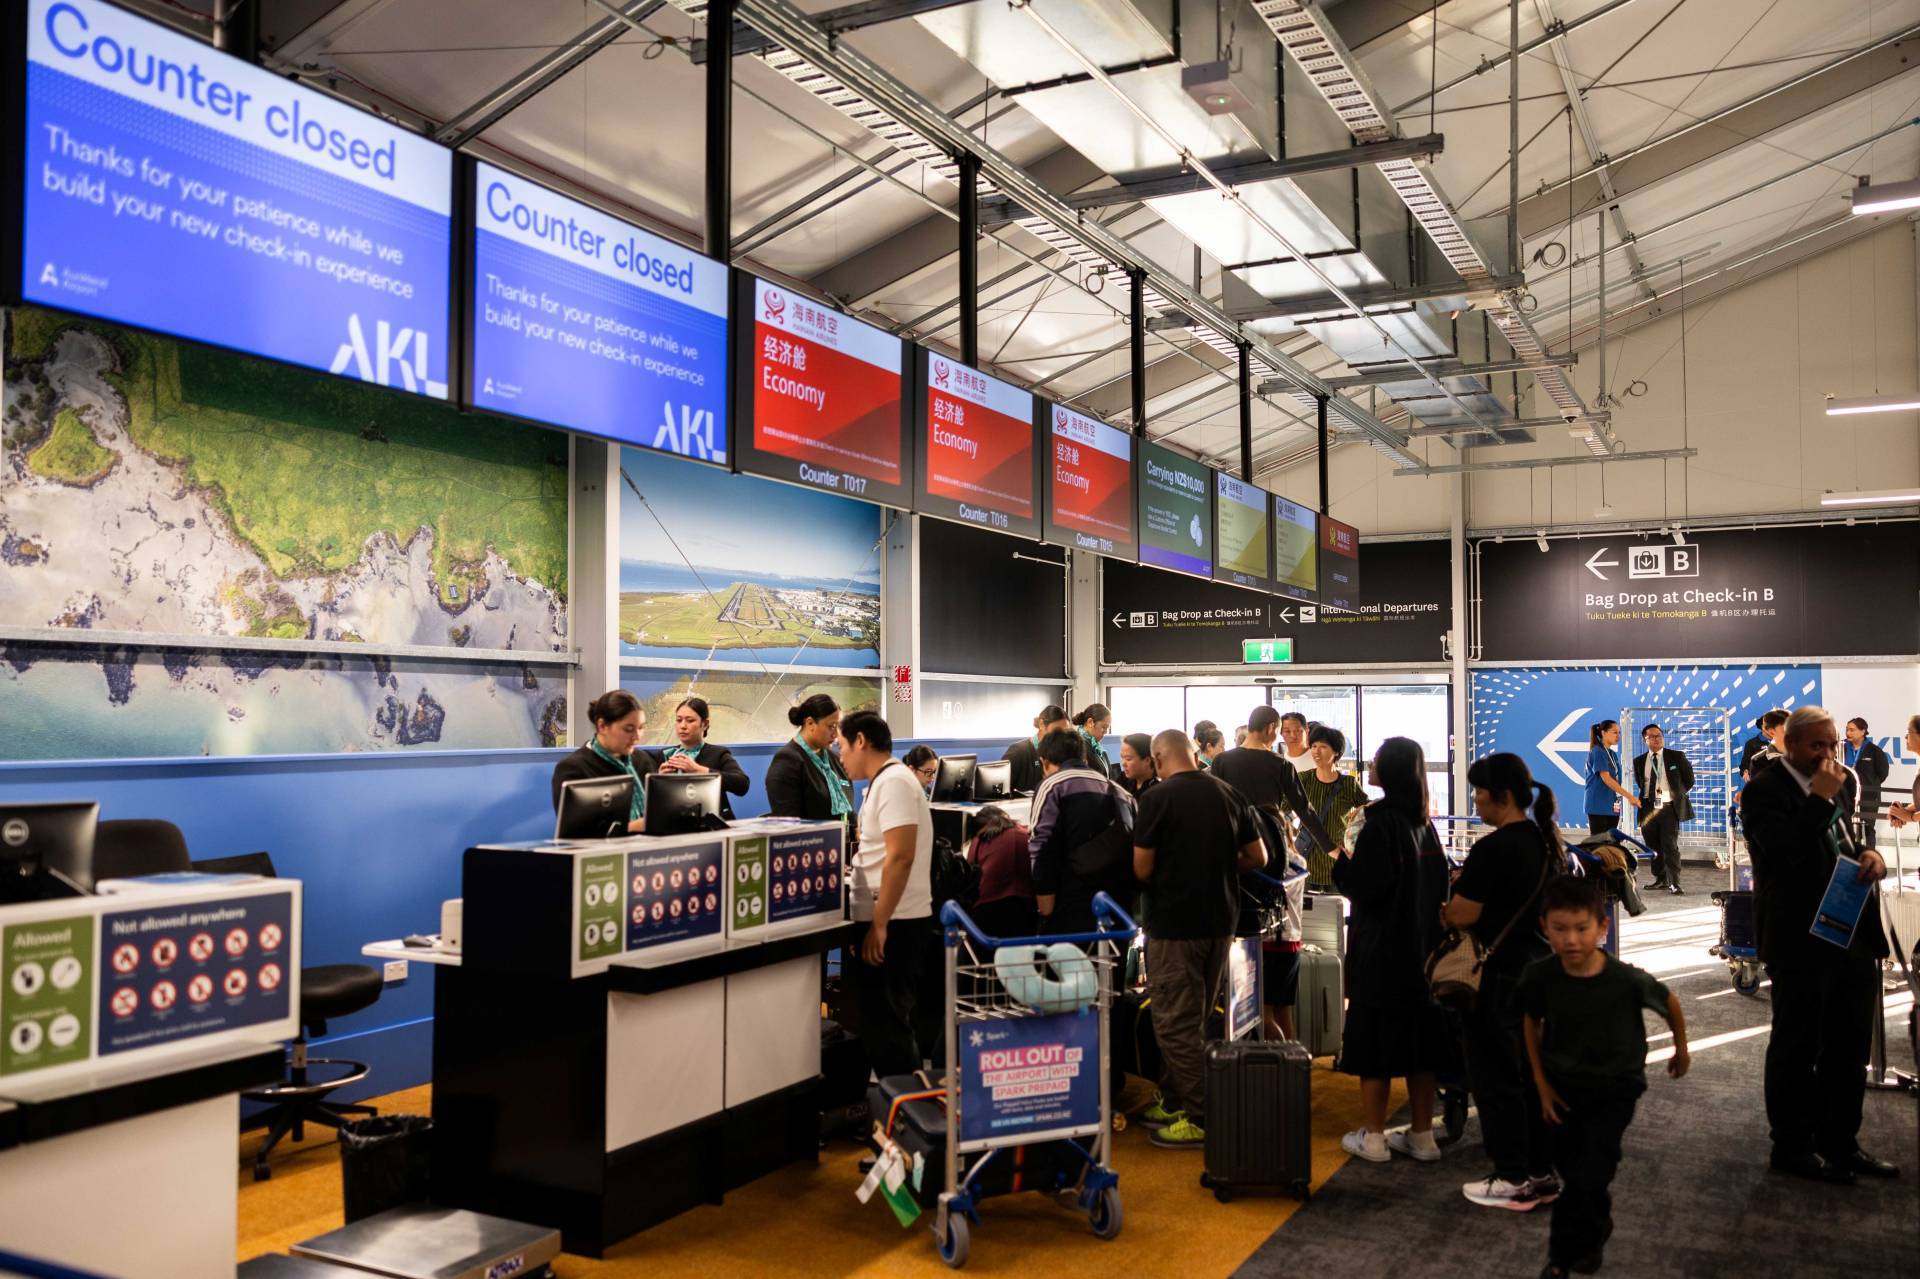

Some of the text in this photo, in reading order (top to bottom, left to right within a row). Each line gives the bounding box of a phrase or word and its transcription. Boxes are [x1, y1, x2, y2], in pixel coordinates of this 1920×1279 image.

[46, 3, 396, 180] Counter closed
[44, 122, 403, 264] Thanks for your patience while we
[43, 163, 413, 299] build your new check-in experience
[486, 181, 694, 295] Counter closed
[486, 273, 699, 360] Thanks for your patience while we
[792, 302, 838, 336] 海南航空
[330, 314, 448, 400] AKL
[485, 304, 705, 387] build your new check-in experience
[763, 335, 807, 371] 经济舱
[763, 366, 825, 412] Economy
[934, 397, 964, 426] 经济舱
[652, 400, 726, 464] AKL
[933, 423, 978, 460] Economy
[1056, 442, 1079, 466] 经济舱
[800, 463, 867, 494] Counter T017
[1056, 464, 1090, 495] Economy
[1147, 460, 1174, 486] Carrying
[1174, 470, 1205, 494] NZ$10,000
[959, 503, 988, 522] Counter
[1076, 533, 1098, 549] Counter
[1673, 551, 1690, 571] B
[1384, 603, 1439, 614] Departures
[1585, 588, 1774, 608] Bag Drop at Check-in B
[1147, 614, 1155, 625] B
[1162, 608, 1261, 621] Bag Drop at Check-in B
[1586, 612, 1605, 620] Tuku
[1607, 611, 1631, 619] Tueke
[1651, 610, 1699, 620] Tomokanga
[633, 857, 645, 868] Not
[112, 907, 246, 935] Not allowed anywhere
[13, 926, 72, 948] Allowed
[981, 1045, 1082, 1070] ROLL OUT OF
[986, 1065, 1077, 1083] THE AIRPORT WITH
[995, 1081, 1068, 1098] SPARK PREPAID
